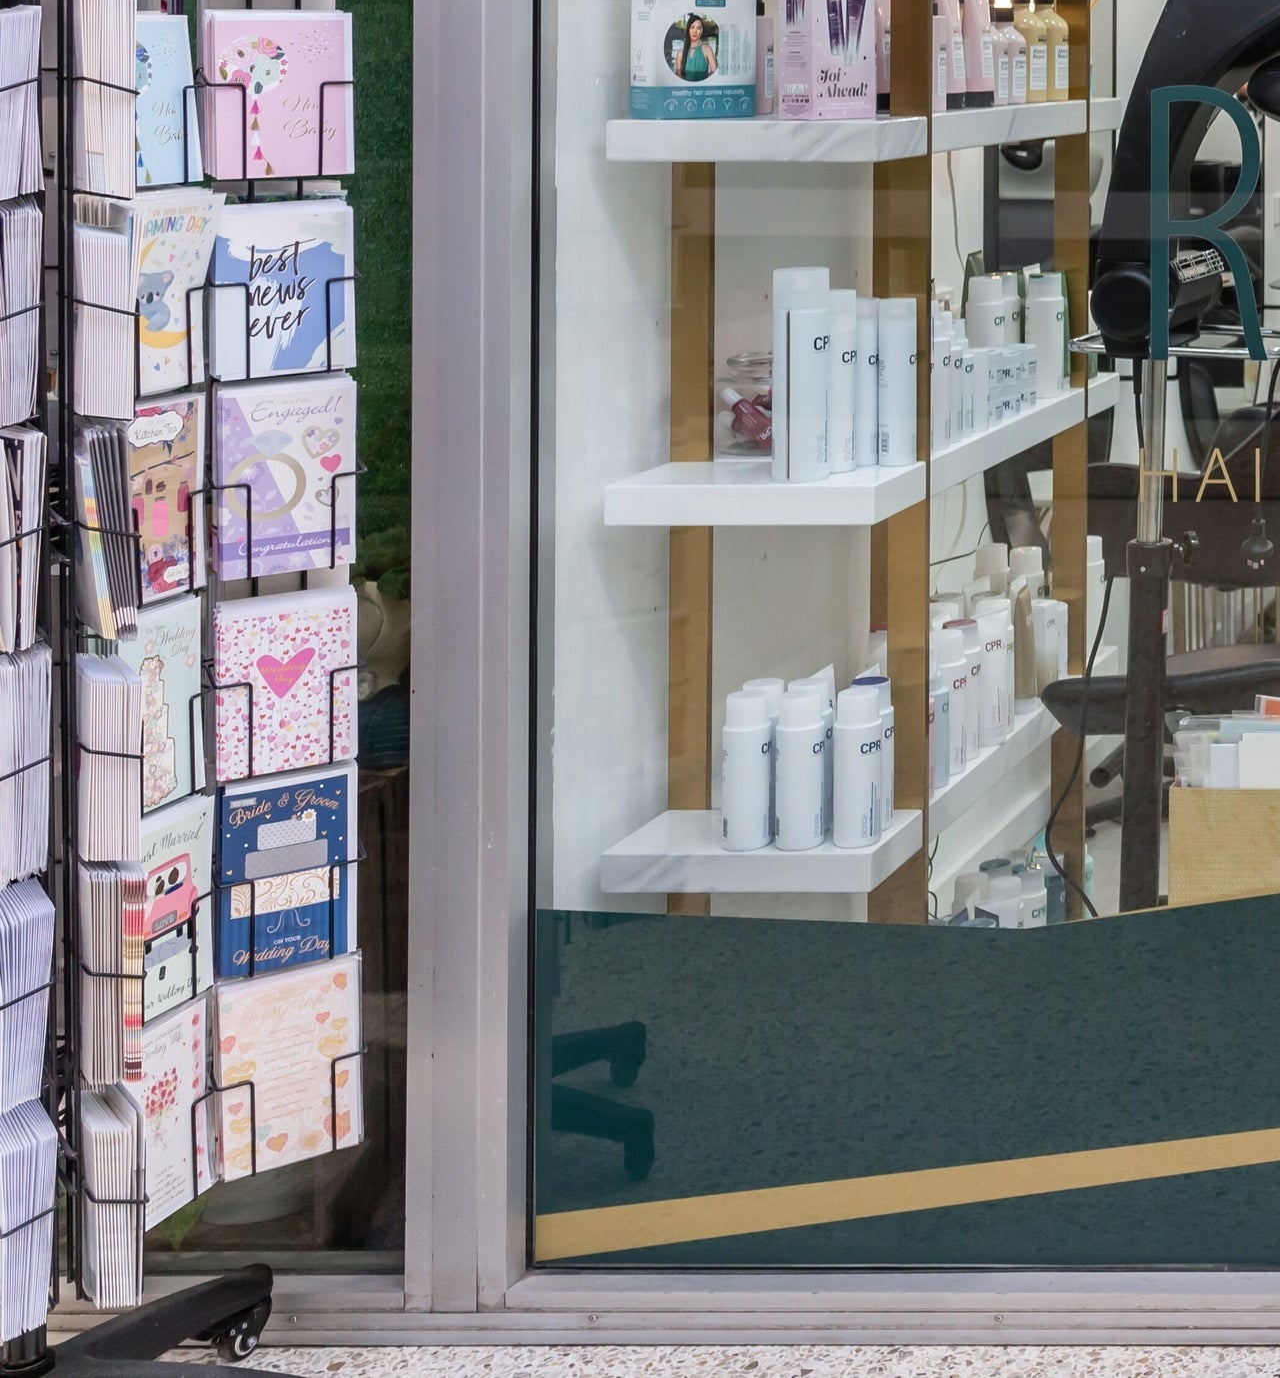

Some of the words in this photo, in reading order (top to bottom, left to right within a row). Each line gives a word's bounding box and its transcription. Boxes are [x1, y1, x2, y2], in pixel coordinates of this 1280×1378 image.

[250, 238, 317, 281] best
[249, 274, 316, 308] news
[249, 307, 310, 339] ever
[251, 395, 343, 426] Engaged!
[238, 534, 338, 557] Congratulation
[156, 623, 197, 647] Wedding
[985, 638, 1002, 653] CPR
[884, 726, 894, 740] CP
[812, 740, 825, 755] CP
[229, 800, 272, 829] Bride
[278, 792, 290, 808] &
[293, 788, 340, 812] Groom
[141, 843, 158, 864] ust
[161, 823, 203, 848] Married
[285, 935, 301, 943] YOUR
